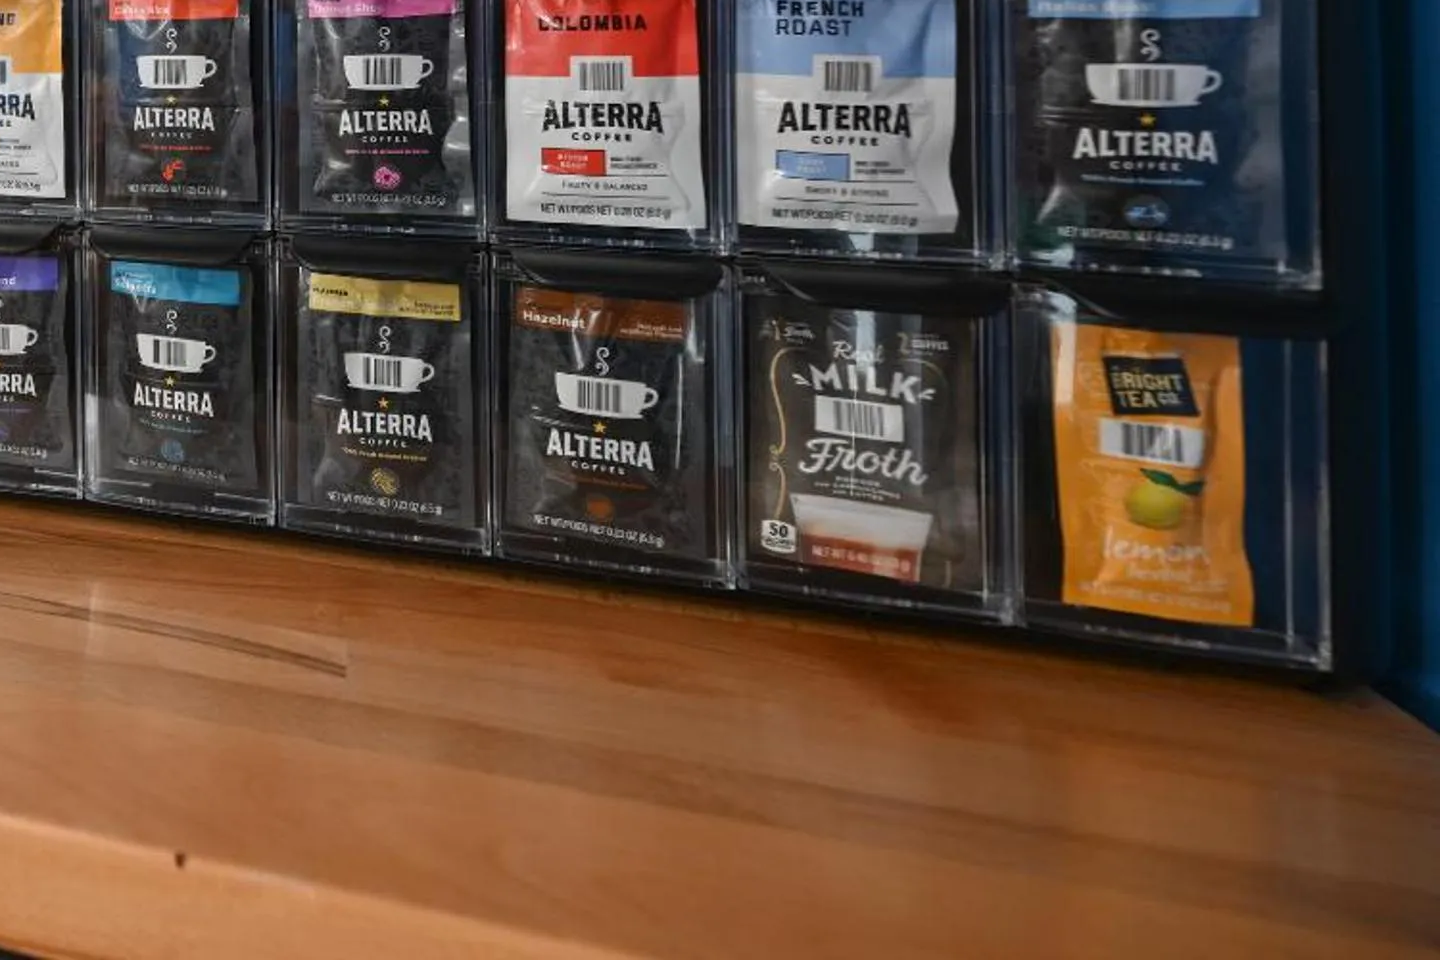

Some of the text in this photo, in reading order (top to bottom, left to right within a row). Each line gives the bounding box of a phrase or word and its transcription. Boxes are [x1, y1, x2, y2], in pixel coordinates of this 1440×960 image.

[538, 13, 648, 32] COLOMBIA
[776, 18, 853, 37] ROAST
[133, 105, 215, 132] ALTERRA
[339, 109, 434, 137] ALTERRA
[541, 99, 665, 135] ALTERRA
[777, 101, 913, 138] ALTERRA
[362, 135, 408, 143] COFFEE
[571, 132, 633, 142] COFFEE
[811, 135, 880, 147] COFFEE
[1072, 128, 1219, 165] ALTERRA
[1110, 160, 1183, 172] COFFEE
[522, 309, 586, 330] Hazelnut
[809, 362, 921, 405] MILK
[1111, 373, 1185, 391] BRIGHT
[133, 381, 215, 418] ALTERRA
[1115, 391, 1159, 408] TEA
[337, 407, 433, 443] ALTERRA
[546, 427, 655, 472] ALTERRA
[571, 460, 626, 476] COFFEE
[798, 437, 929, 486] Froth
[769, 522, 789, 538] 50
